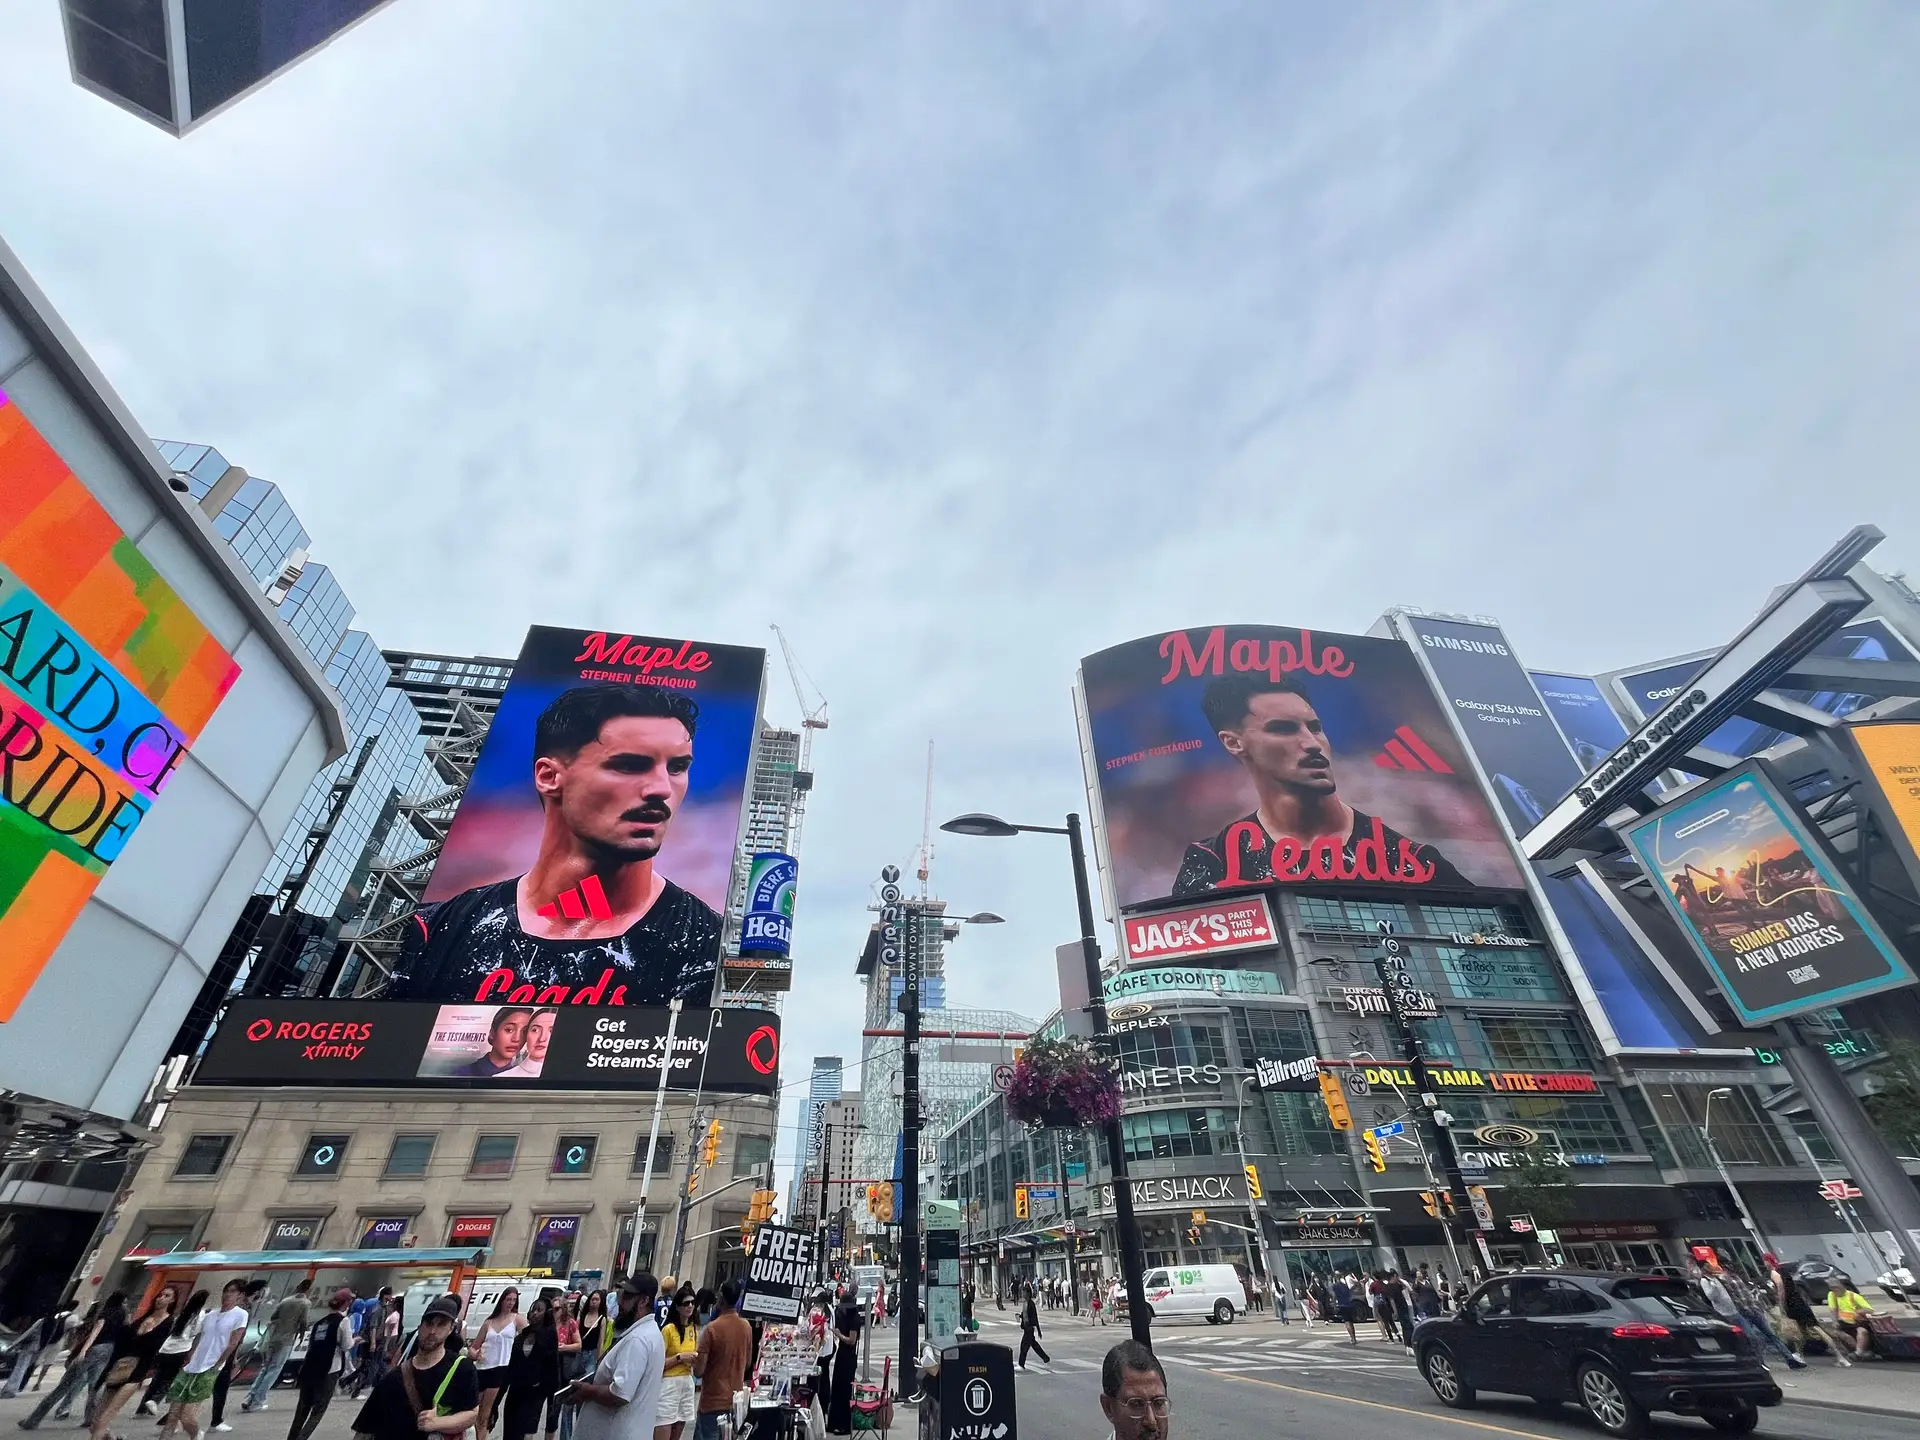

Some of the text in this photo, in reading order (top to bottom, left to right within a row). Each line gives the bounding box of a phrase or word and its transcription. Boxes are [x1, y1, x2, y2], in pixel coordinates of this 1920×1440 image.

[575, 632, 712, 673] Maple
[1422, 634, 1508, 656] SAMSUNG
[1158, 627, 1355, 684] Maple
[0, 577, 119, 755] ARD,
[580, 669, 696, 689] STEPHEN EUSTÁQUIO
[1455, 699, 1541, 717] Galaxy S26 Ultra
[1477, 713, 1510, 725] Galaxy
[1591, 689, 1707, 791] sankofa square
[1105, 751, 1146, 770] STEPHEN
[0, 702, 145, 866] RIDE
[1216, 817, 1436, 888] Leads
[757, 869, 785, 903] BIÈRE
[881, 865, 900, 965] Yonge
[1228, 909, 1257, 920] PARTY
[1230, 920, 1253, 929] THIS
[1131, 914, 1230, 953] JACK'S
[1232, 928, 1253, 939] WAY
[1729, 911, 1820, 953] SUMMER HAS
[908, 915, 917, 991] DOWNTOWN
[1734, 925, 1844, 973] A NEW ADDRESS
[1501, 964, 1537, 973] COMING
[1113, 974, 1148, 993] CAFE
[1151, 972, 1226, 986] TORONTO
[1512, 977, 1538, 986] SOON
[275, 1021, 373, 1041] ROGERS
[595, 1017, 627, 1032] Get
[434, 1031, 487, 1043] THE TESTAMENTS
[591, 1034, 650, 1053] Rogers
[301, 1041, 365, 1060] xfinity
[1255, 1055, 1319, 1088] ballroom
[1257, 1057, 1273, 1069] The
[1364, 1068, 1485, 1086] DOLLRAMA
[1534, 1072, 1598, 1092] CANADA
[1103, 1176, 1235, 1207] SHKE SHACK
[276, 1223, 301, 1236] fido
[464, 1223, 491, 1231] ROGERS
[626, 1219, 646, 1231] fio
[1298, 1227, 1361, 1239] SHAKE SHACK
[755, 1228, 811, 1263] FREE
[750, 1257, 806, 1286] QURAN
[968, 1366, 987, 1374] TRASH
